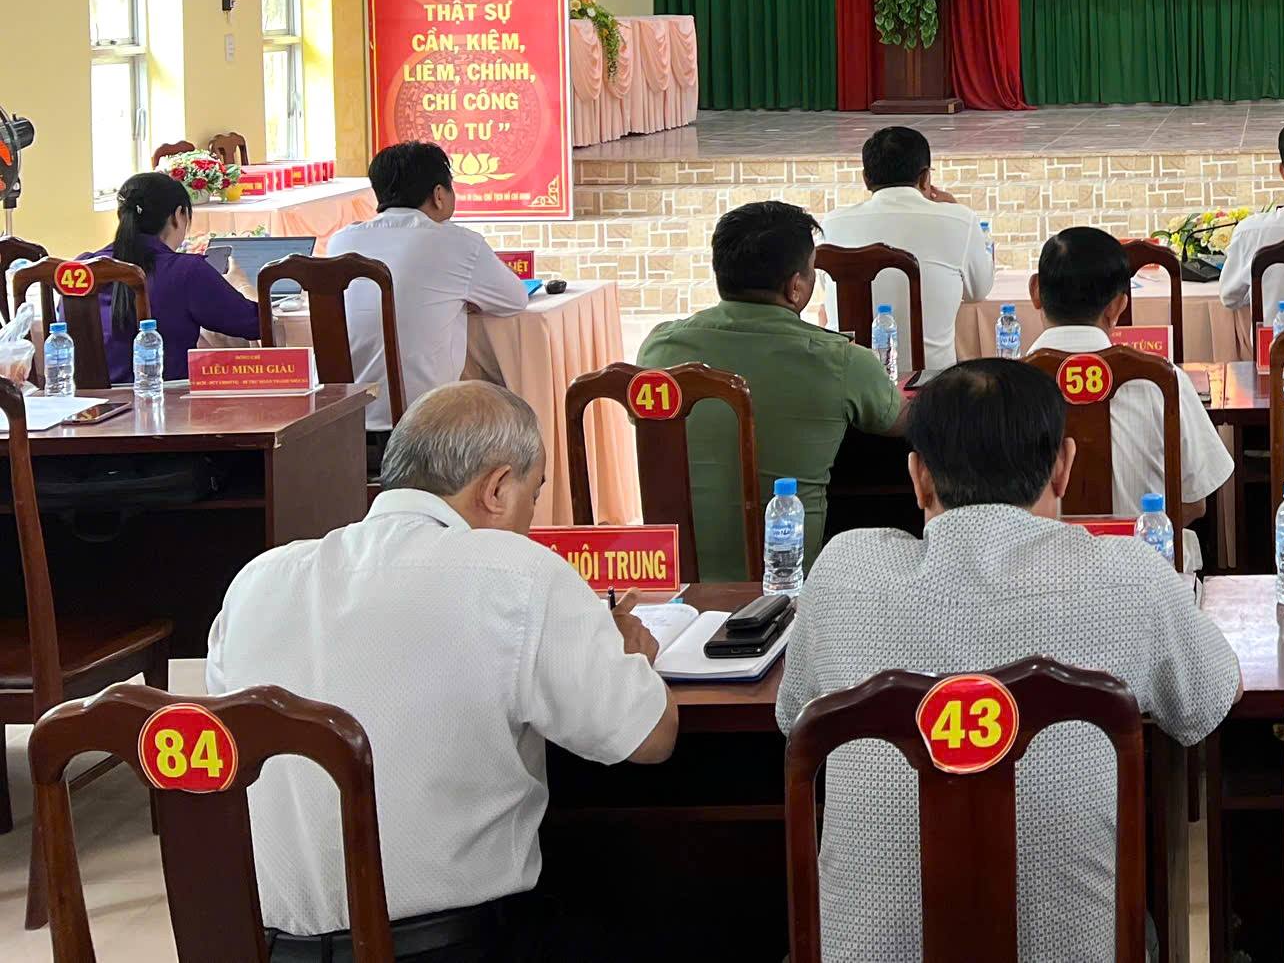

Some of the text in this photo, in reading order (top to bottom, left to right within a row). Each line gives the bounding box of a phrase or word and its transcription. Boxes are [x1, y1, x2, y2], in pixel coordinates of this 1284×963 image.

[424, 0, 512, 24] THẬT SỰ
[412, 27, 526, 54] CẦN, KIỆM,
[404, 59, 536, 84] LIÊM, CHÍNH,
[422, 90, 519, 111] CHÍ CÔNG
[431, 119, 457, 141] VÔ
[60, 268, 88, 289] 42
[232, 365, 264, 375] MINH
[1065, 364, 1104, 394] 58
[636, 383, 671, 411] 41
[604, 550, 667, 580] TRUNG
[930, 697, 1002, 749] 43
[154, 728, 224, 779] 84
